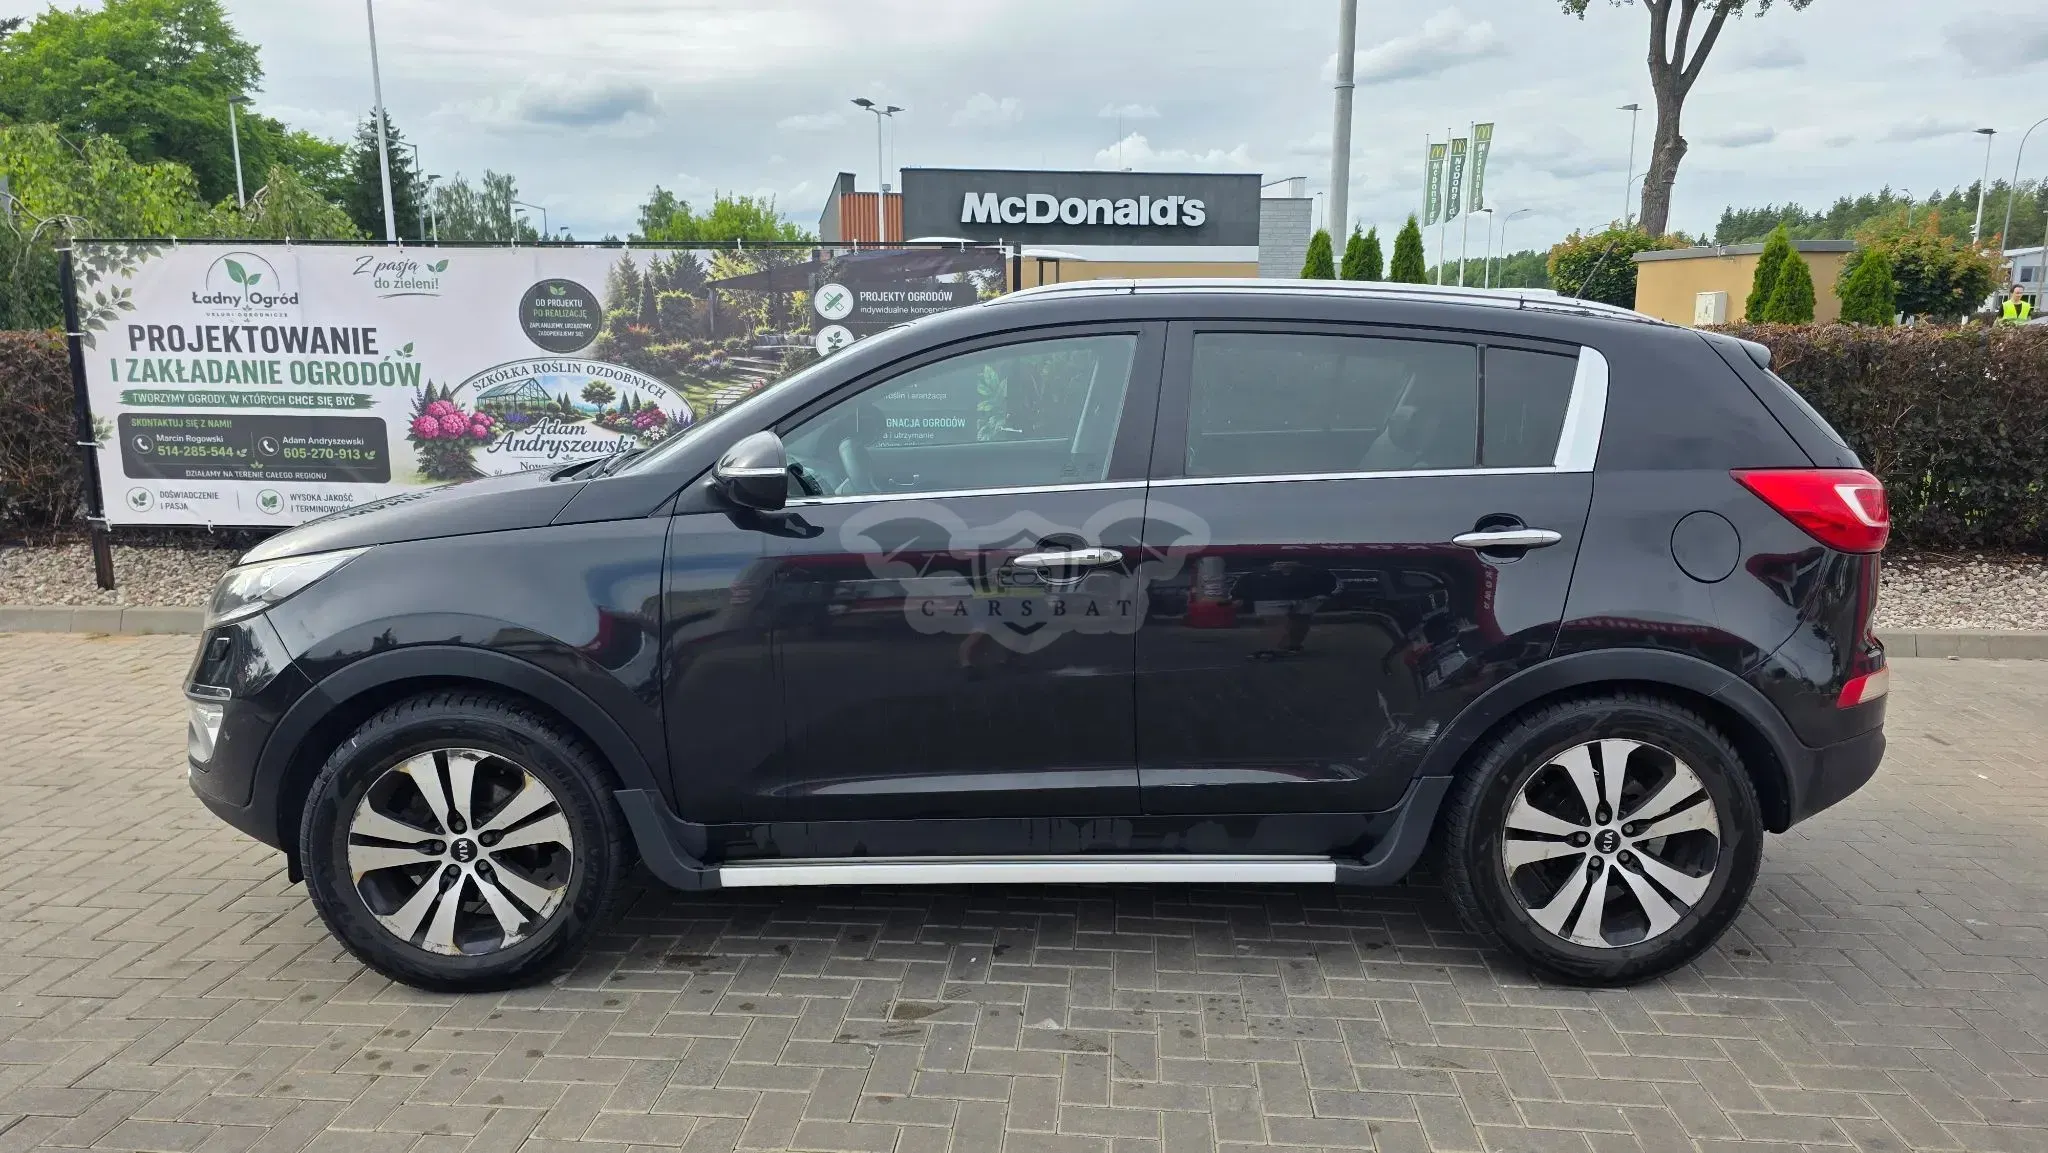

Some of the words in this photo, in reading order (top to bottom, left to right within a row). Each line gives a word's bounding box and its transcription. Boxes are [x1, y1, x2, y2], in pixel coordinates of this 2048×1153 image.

[961, 192, 1206, 227] McDonald's
[353, 255, 374, 276] Z
[373, 259, 418, 278] pasją
[374, 278, 389, 289] do
[394, 278, 439, 289] zieleni!
[192, 291, 241, 307] Ładny
[249, 292, 299, 308] Ogród
[860, 291, 905, 302] PROJEKTY
[908, 290, 953, 302] OGRODÓW
[535, 299, 545, 307] OD
[547, 299, 583, 307] PROJEKTU
[533, 309, 543, 317] PO
[545, 309, 587, 319] REALIZACJĘ
[860, 306, 908, 315] indywidualne
[128, 324, 379, 355] PROJEKTOWANIE
[111, 358, 119, 382] I
[126, 358, 281, 385] ZAKŁADANIE
[290, 357, 421, 387] OGRODÓW
[472, 365, 529, 392] SZKÓŁKA
[533, 360, 582, 375] ROŚLIN
[586, 364, 667, 400] OZDOBNYCH
[133, 393, 185, 404] TWORZYMY
[188, 393, 228, 405] OGRODY,
[230, 394, 239, 404] W
[242, 392, 286, 405] KTÓRYCH
[288, 395, 314, 406] CHCE
[317, 395, 333, 407] SIĘ
[336, 394, 356, 406] BYĆ
[131, 418, 184, 428] SKONTAKTUJ
[186, 419, 198, 430] SIĘ
[200, 419, 206, 428] Z
[208, 419, 232, 429] NAMI!
[525, 417, 587, 436] Adam
[922, 416, 966, 428] OGRODÓW
[156, 434, 184, 442] Marcin
[186, 435, 224, 444] Rogowski
[283, 436, 306, 444] Adam
[308, 437, 364, 446] Andryszewski
[894, 432, 934, 440] utrzymanie
[157, 445, 234, 457] 514-285-544
[487, 431, 637, 459] Andryszewski
[283, 448, 361, 460] 605-270-913
[223, 470, 233, 478] NA
[266, 471, 293, 479] CAŁEGO
[295, 472, 327, 480] REGIONU
[159, 490, 220, 500] DOŚWIADCZENIE
[290, 494, 321, 502] WYSOKA
[323, 493, 354, 502] JAKOŚĆ
[1602, 831, 1614, 852] KIA
[458, 840, 469, 861] KIA
